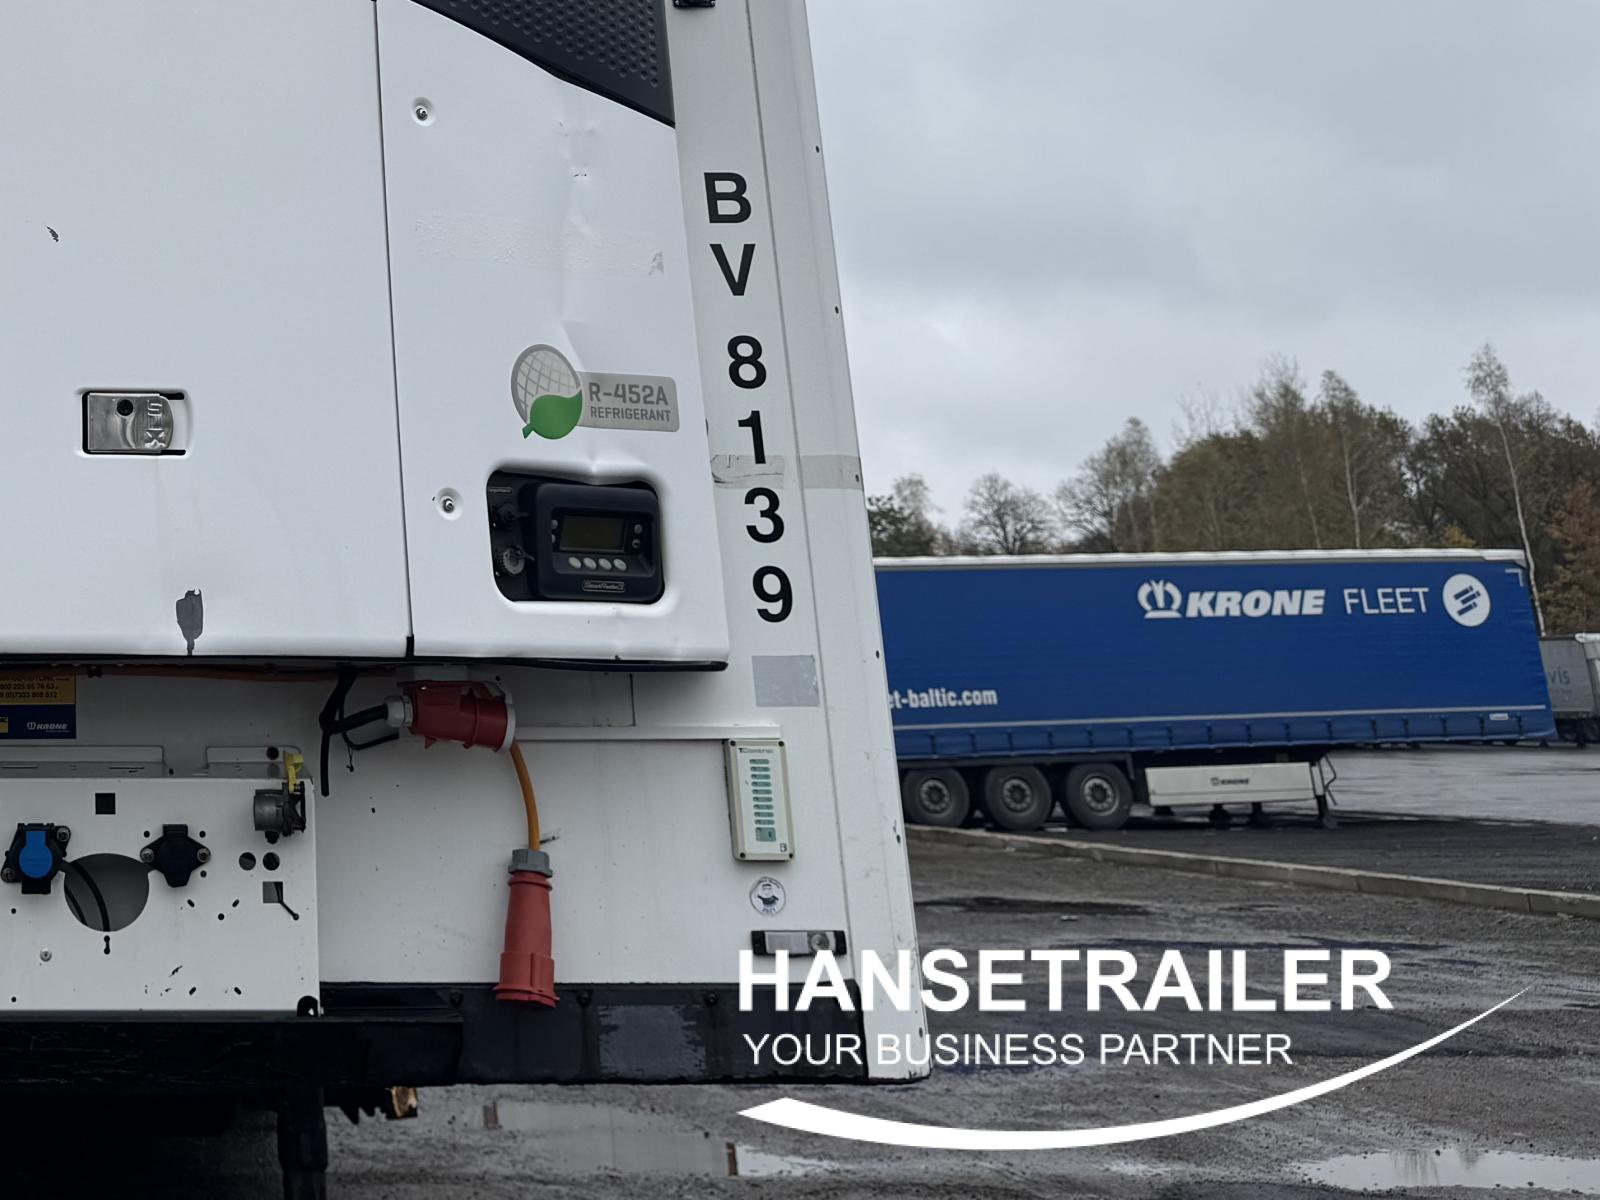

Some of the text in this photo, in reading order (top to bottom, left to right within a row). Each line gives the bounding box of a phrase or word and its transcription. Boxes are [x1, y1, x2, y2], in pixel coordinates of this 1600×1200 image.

[588, 382, 669, 406] R-452A
[590, 406, 671, 422] REFRIGERANT
[1185, 587, 1429, 618] KRONE FLEET
